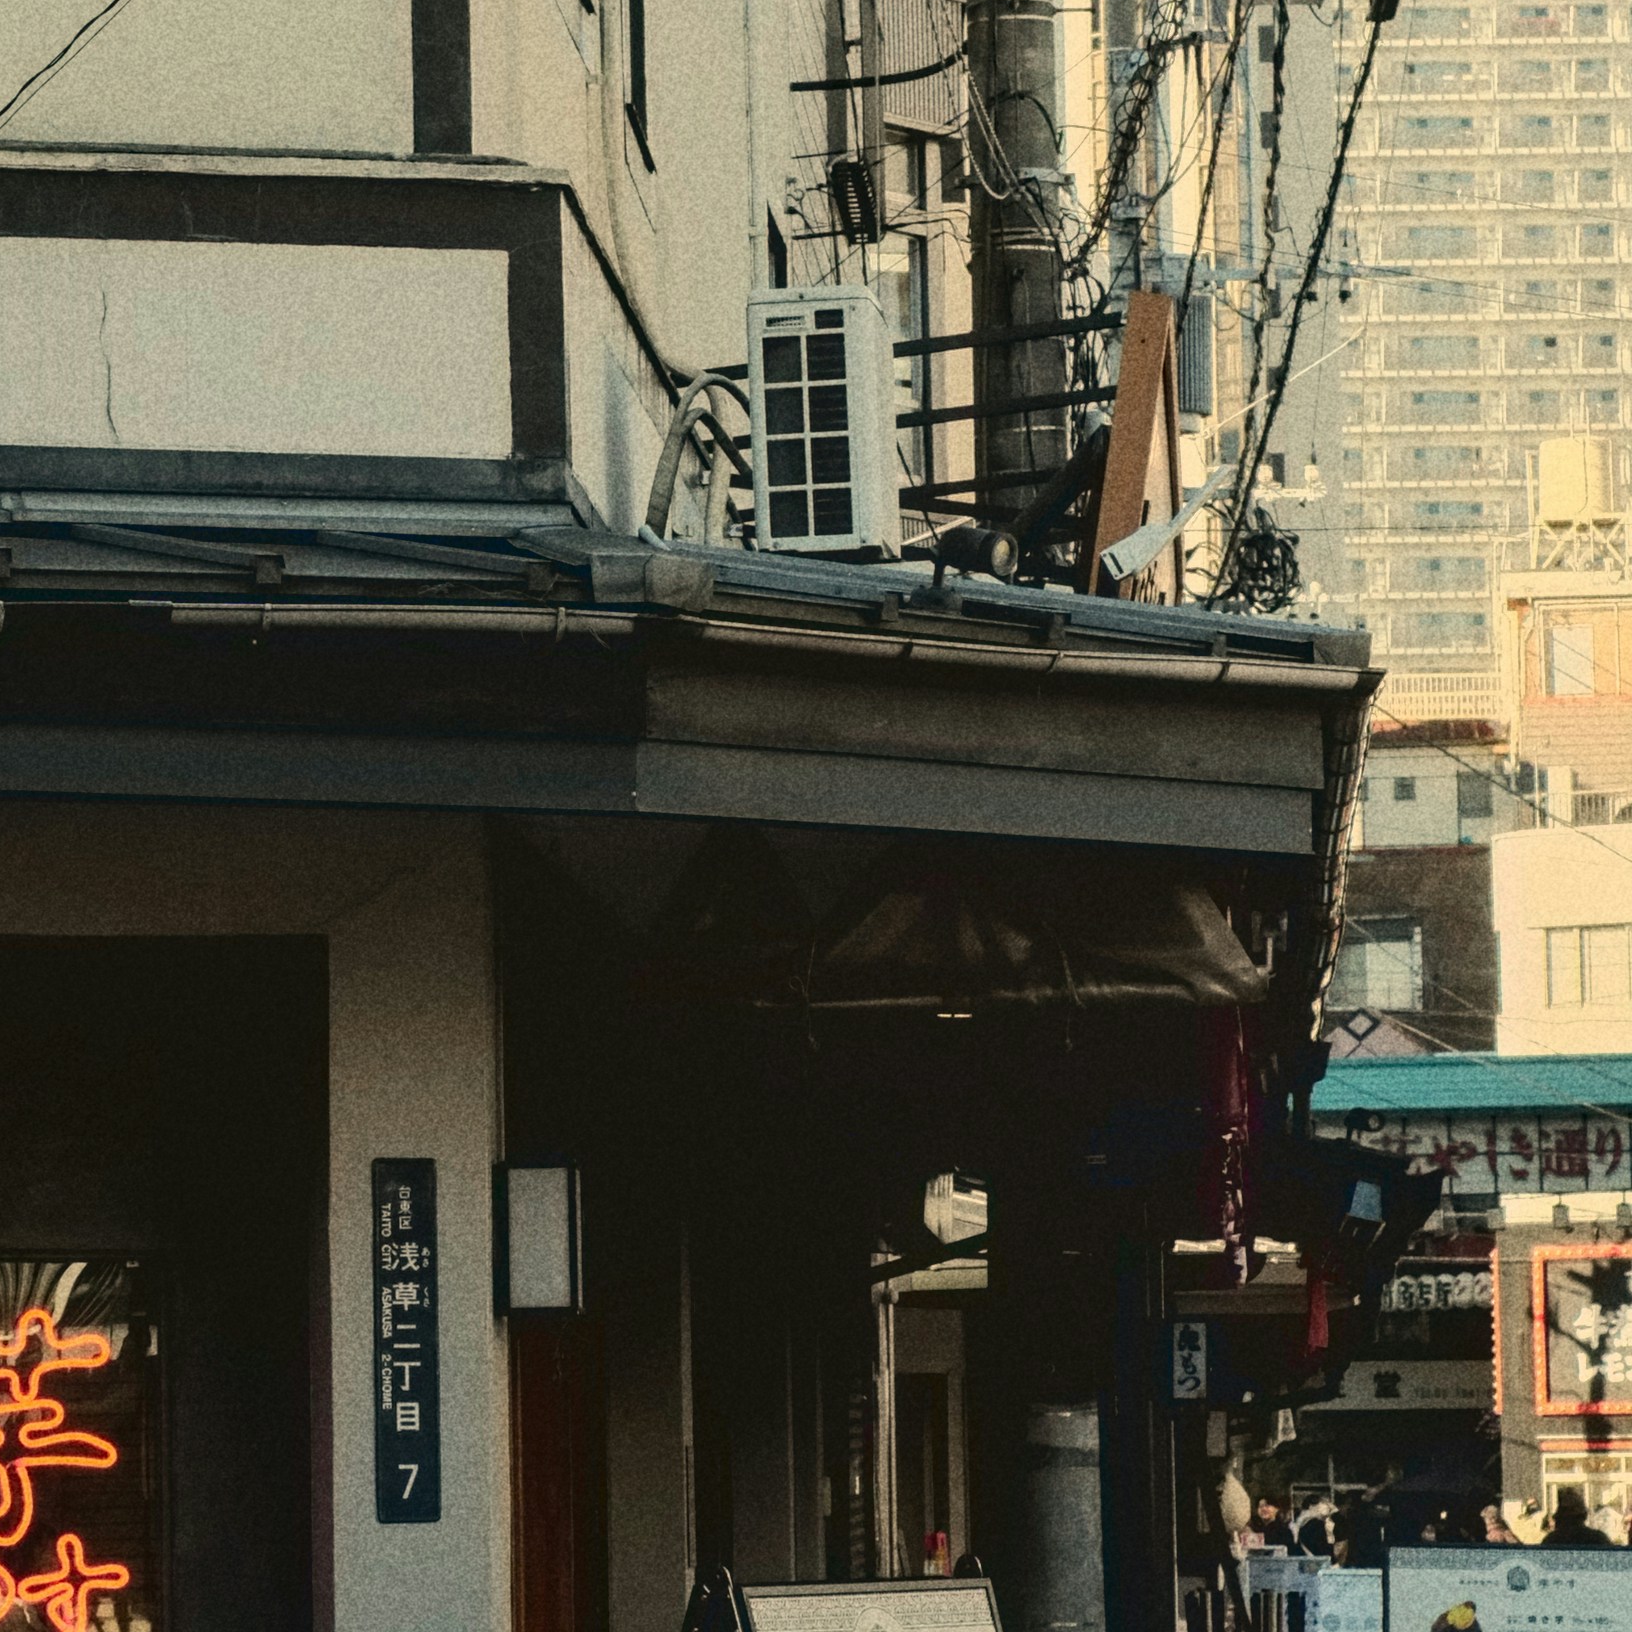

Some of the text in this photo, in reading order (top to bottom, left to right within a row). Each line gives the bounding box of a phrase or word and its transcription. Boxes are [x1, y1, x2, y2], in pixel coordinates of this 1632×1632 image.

[381, 1203, 393, 1410] TAITO CITY ASAKUSA 2-CHOME
[398, 1185, 413, 1230] 台東区
[391, 1241, 421, 1500] 浅草二丁目 7
